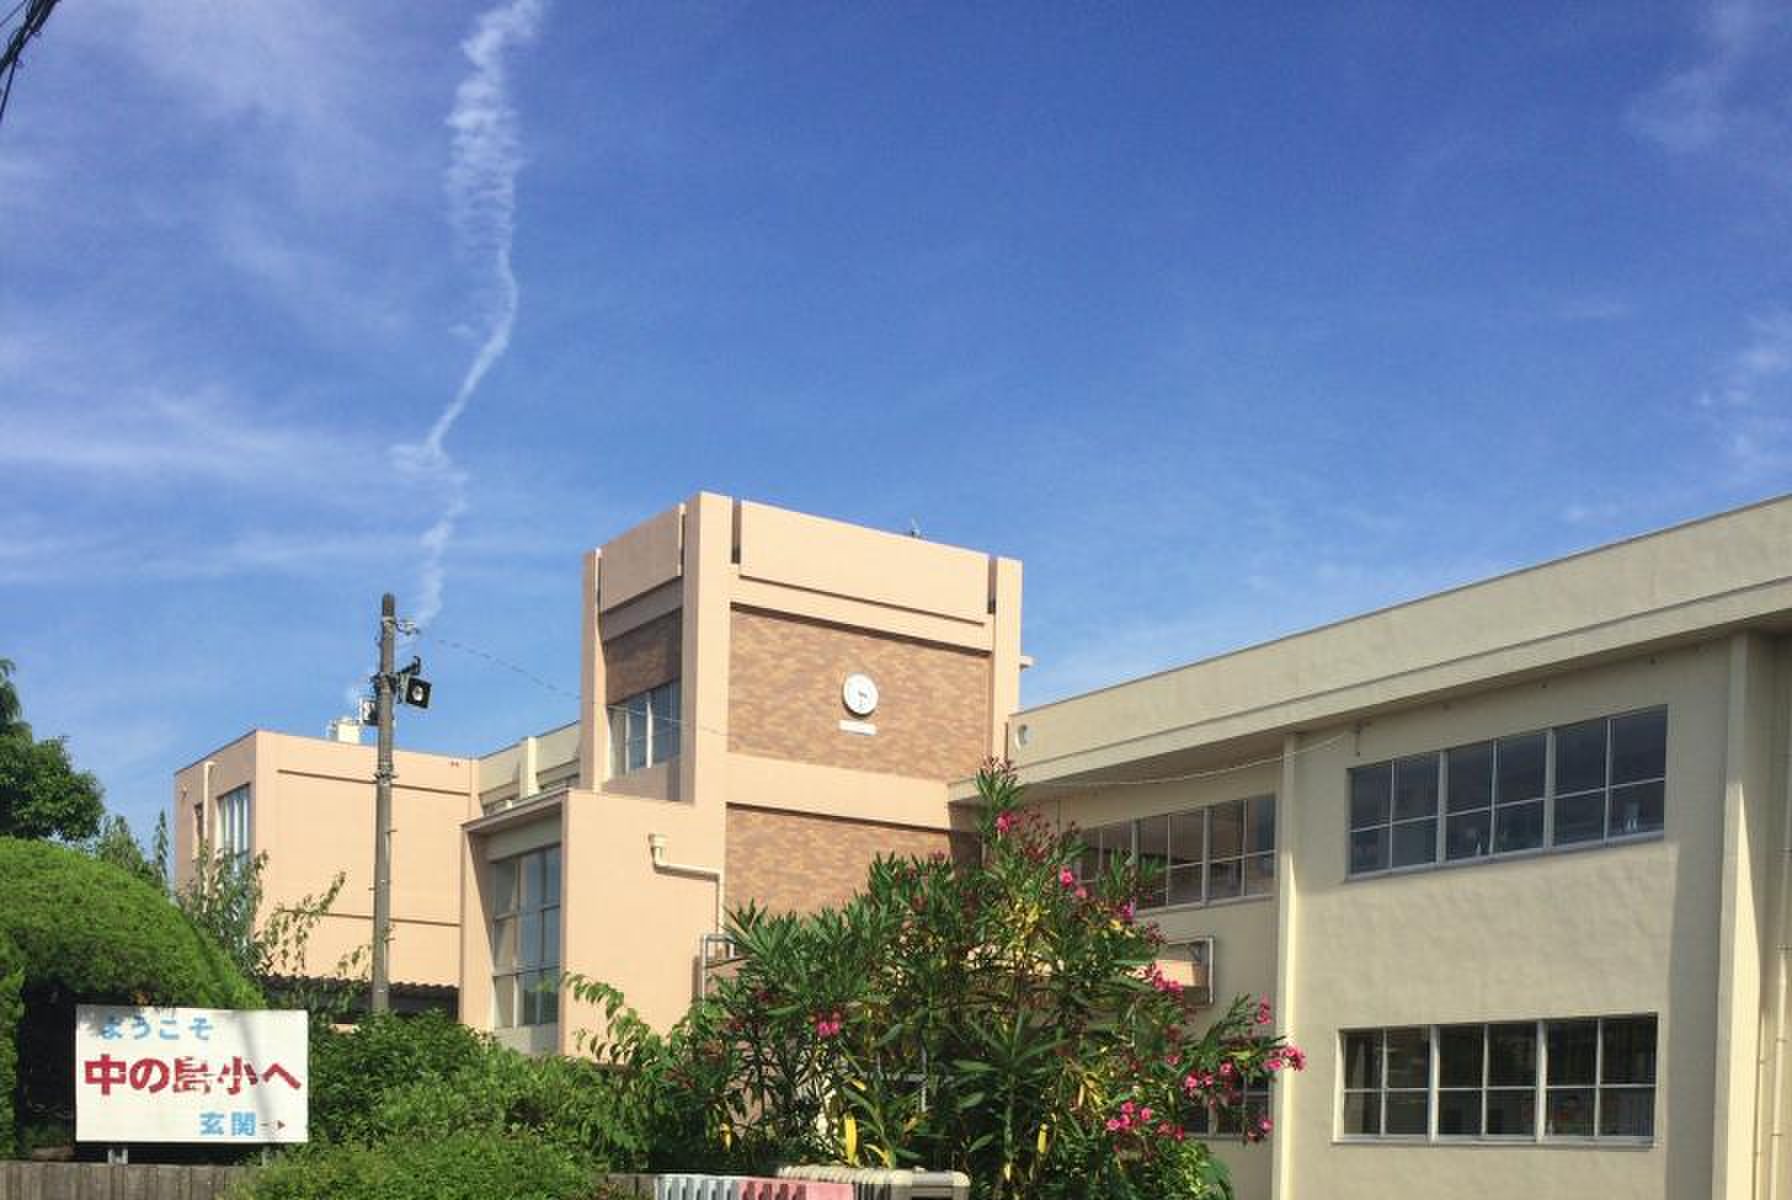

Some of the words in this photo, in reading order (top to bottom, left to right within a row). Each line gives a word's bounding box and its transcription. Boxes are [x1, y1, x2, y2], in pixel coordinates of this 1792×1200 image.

[101, 1015, 213, 1041] ようこそ
[84, 1053, 302, 1096] 中の島小へ
[199, 1111, 257, 1137] 玄関
